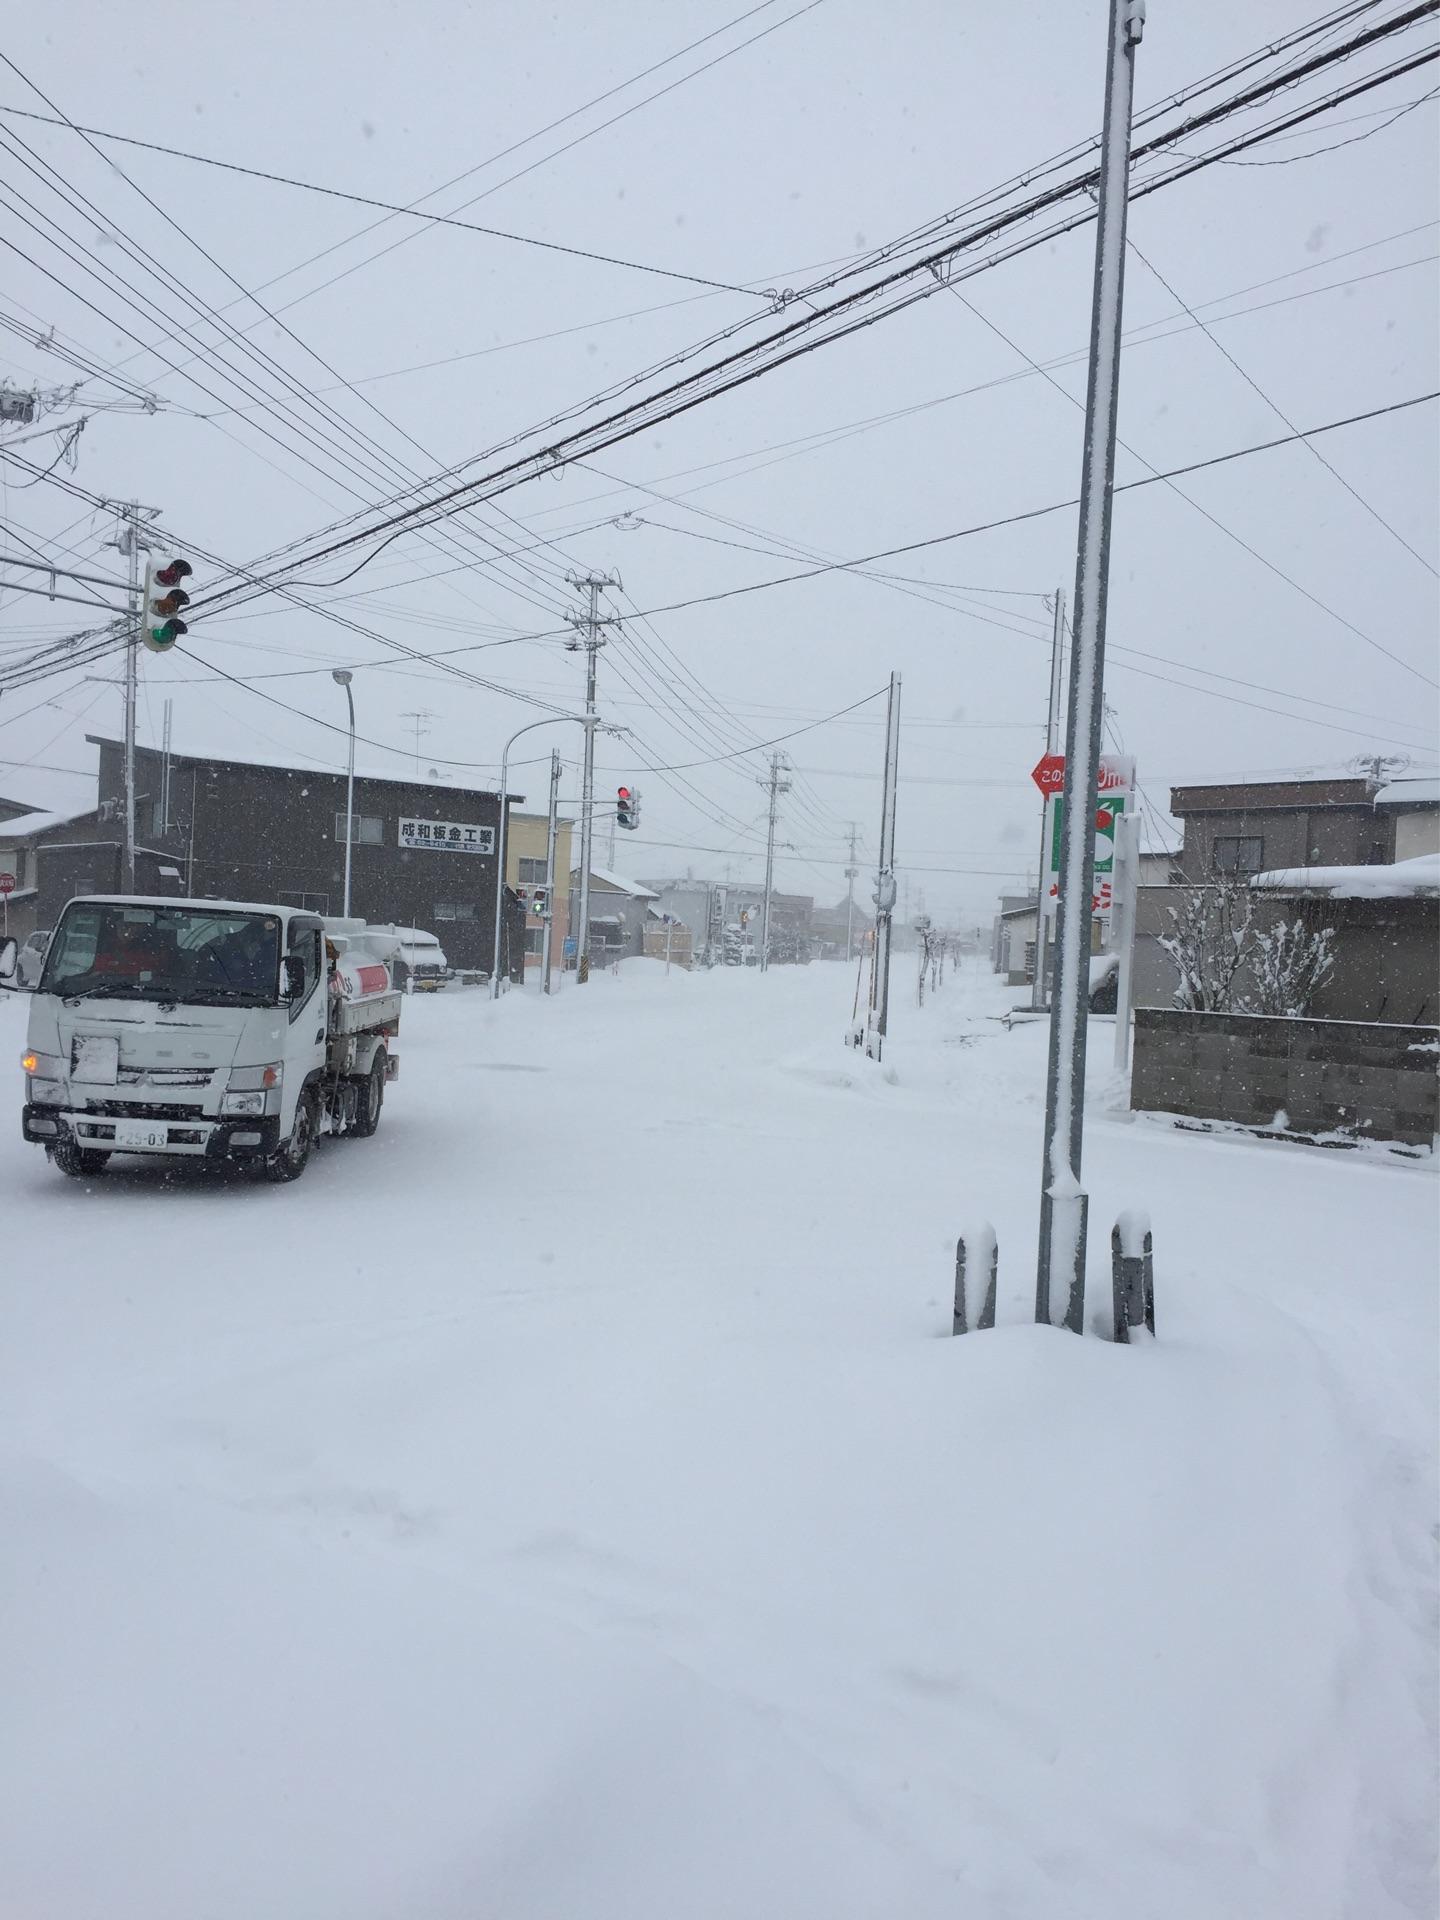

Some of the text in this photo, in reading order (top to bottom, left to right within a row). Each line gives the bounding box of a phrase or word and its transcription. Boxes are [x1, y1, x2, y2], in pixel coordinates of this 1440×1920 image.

[1041, 769, 1065, 783] この
[402, 823, 492, 844] 成和板金工業
